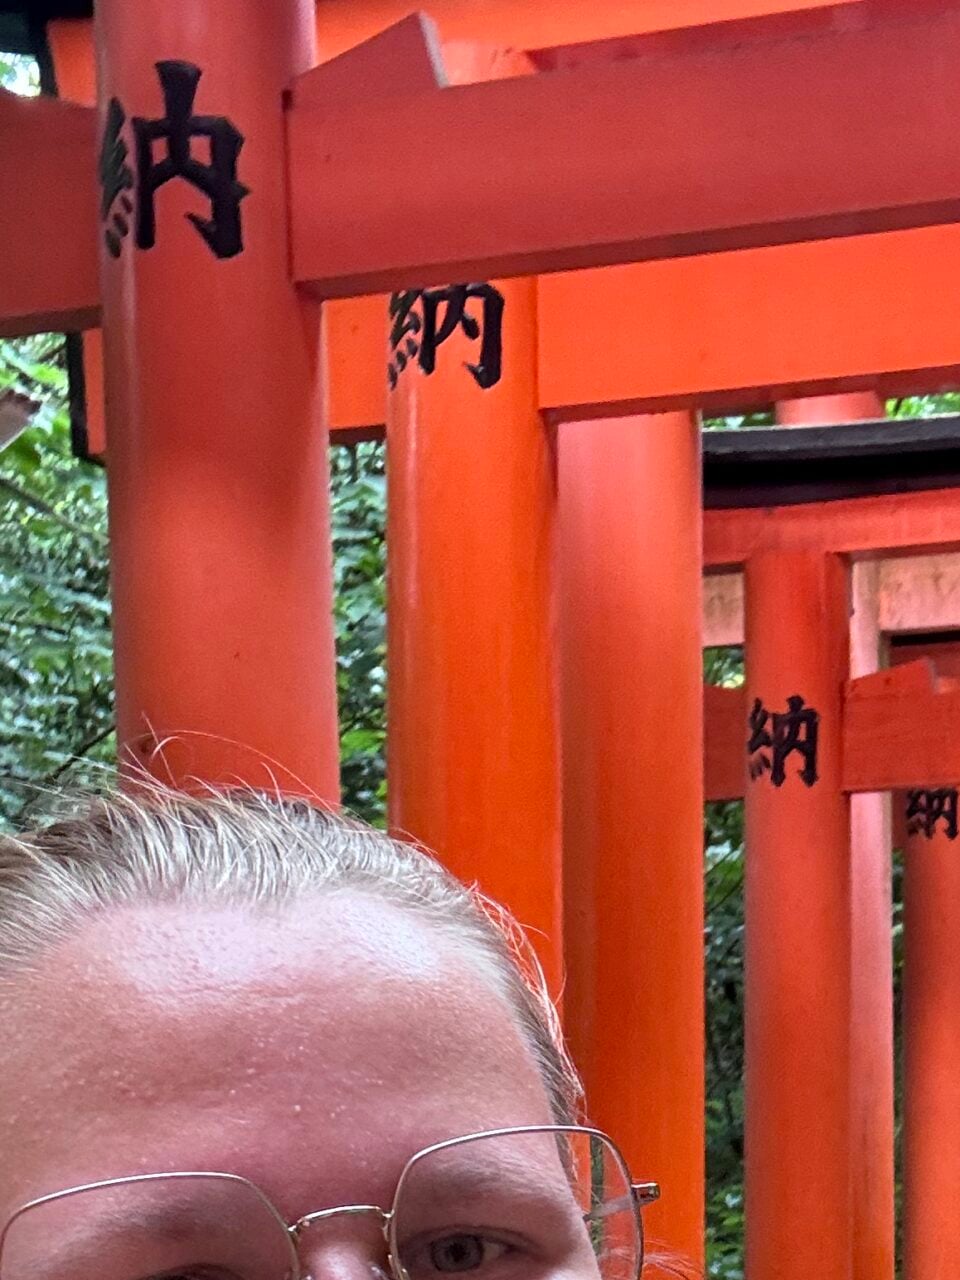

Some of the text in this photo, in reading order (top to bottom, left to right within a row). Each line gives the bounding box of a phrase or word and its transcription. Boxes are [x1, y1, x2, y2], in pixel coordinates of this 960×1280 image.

[101, 60, 250, 258] 納
[388, 283, 505, 390] 納
[747, 695, 820, 787] 納
